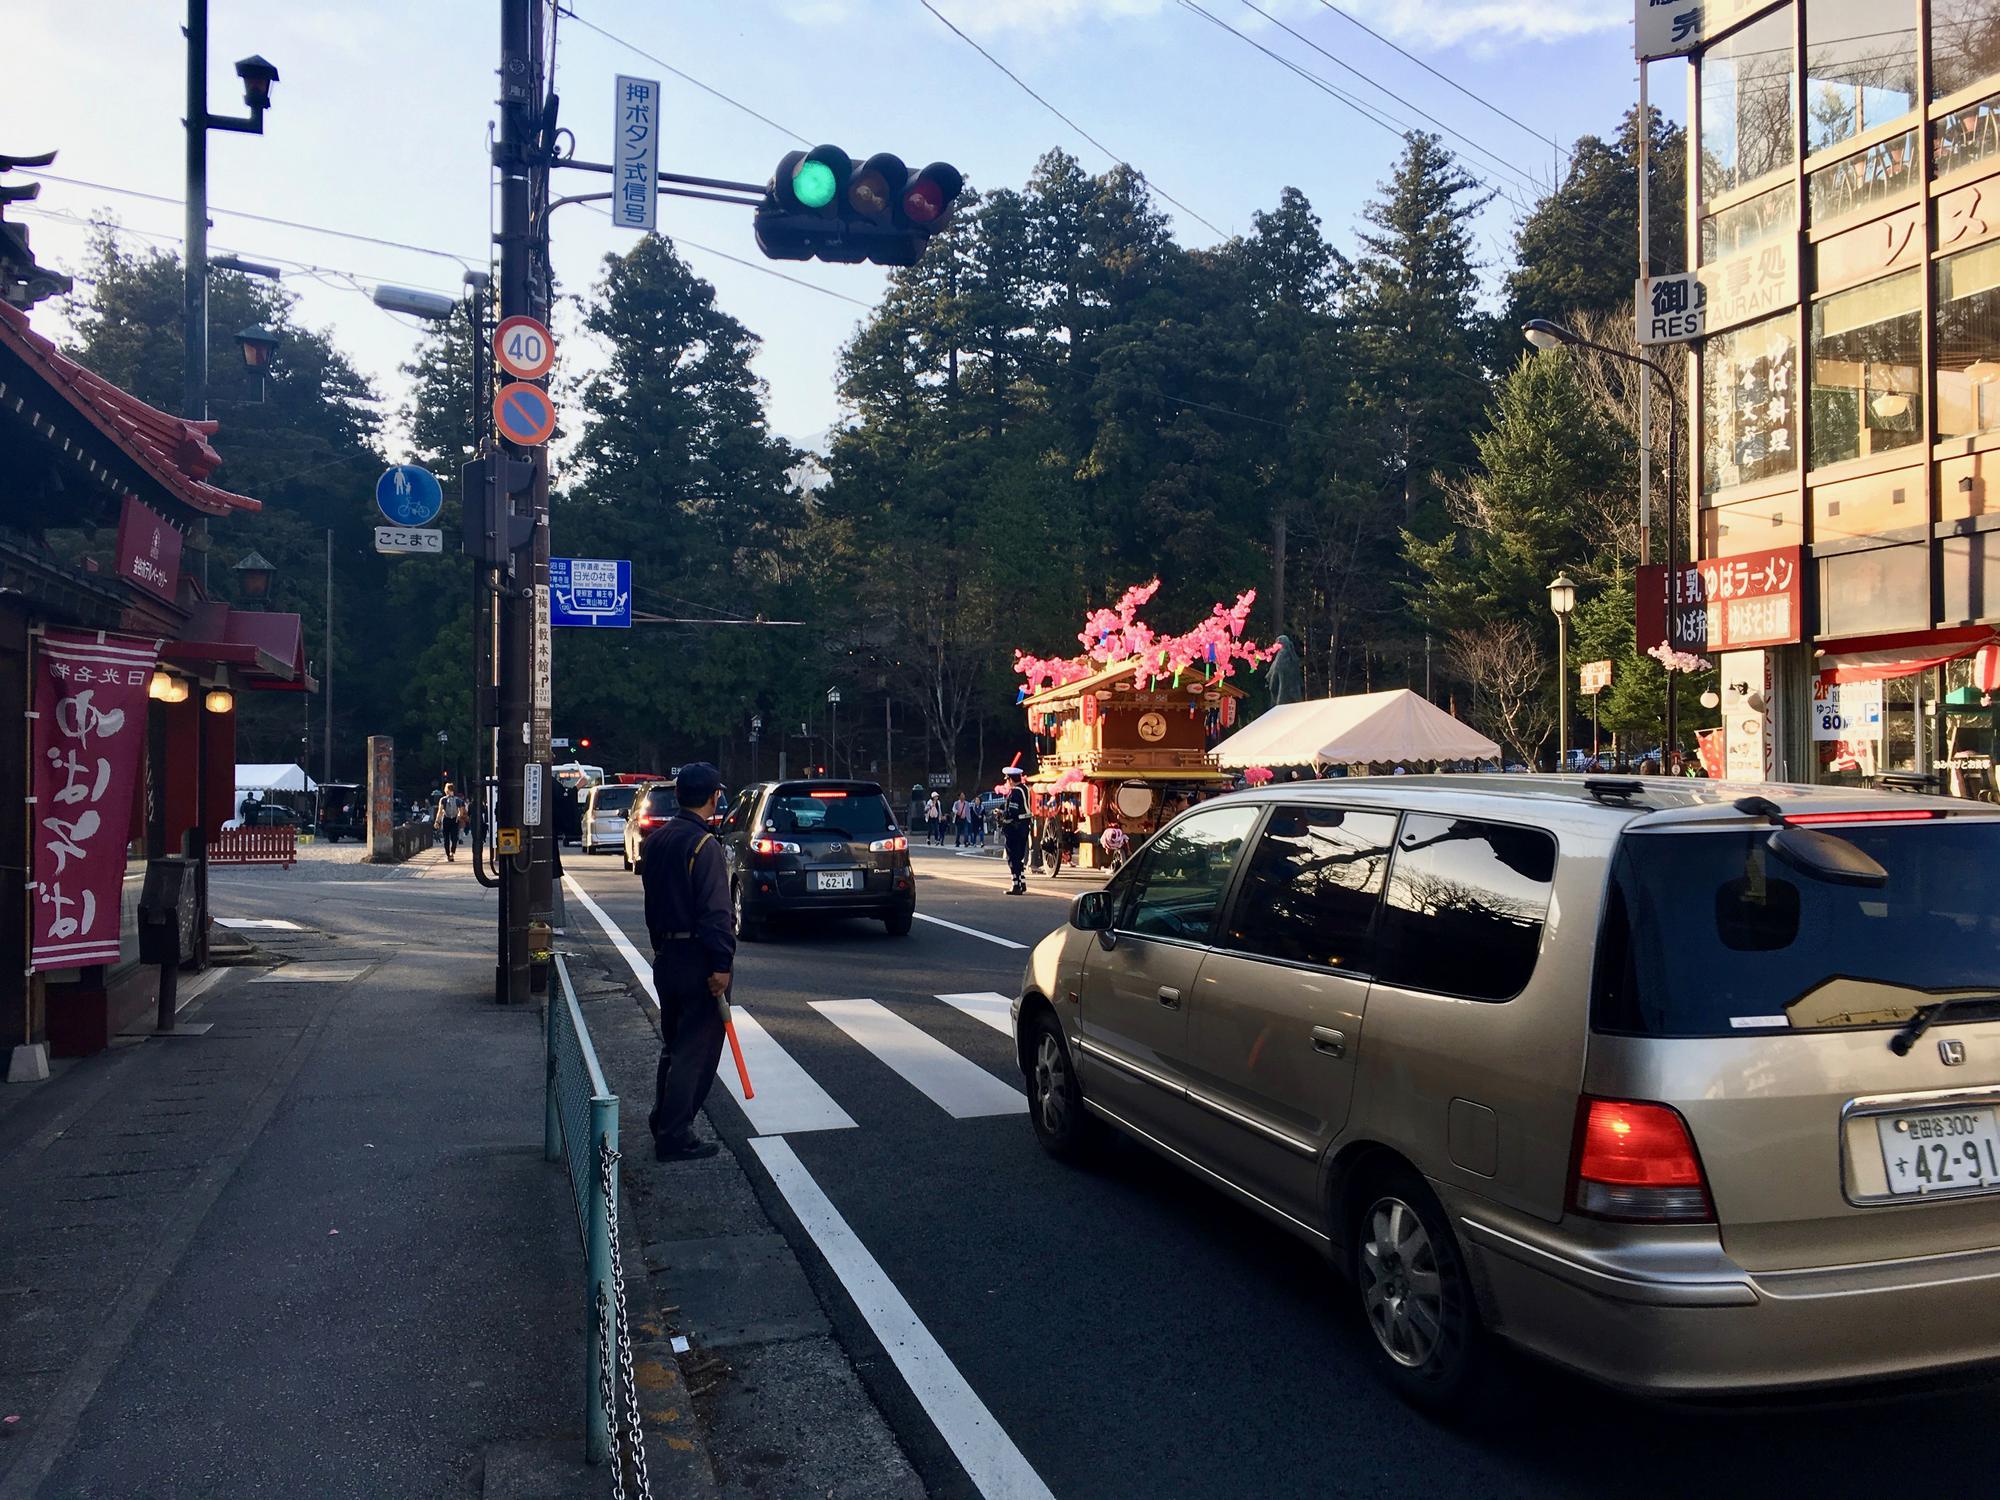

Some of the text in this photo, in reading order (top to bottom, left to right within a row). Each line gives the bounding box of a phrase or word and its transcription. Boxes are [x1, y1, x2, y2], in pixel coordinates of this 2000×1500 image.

[622, 82, 649, 223] 押ボタン式信号
[1651, 244, 1786, 317] 御食事処
[1652, 282, 1785, 339] RESTAURANT
[508, 333, 541, 362] 40
[379, 531, 438, 548] ここまで
[573, 562, 600, 571] 世界遺産
[573, 571, 616, 582] 日光の社寺
[1663, 556, 1793, 604] 豆乳ゆばラーメン
[825, 878, 852, 888] 62-14
[1916, 1138, 1998, 1184] 42-91
